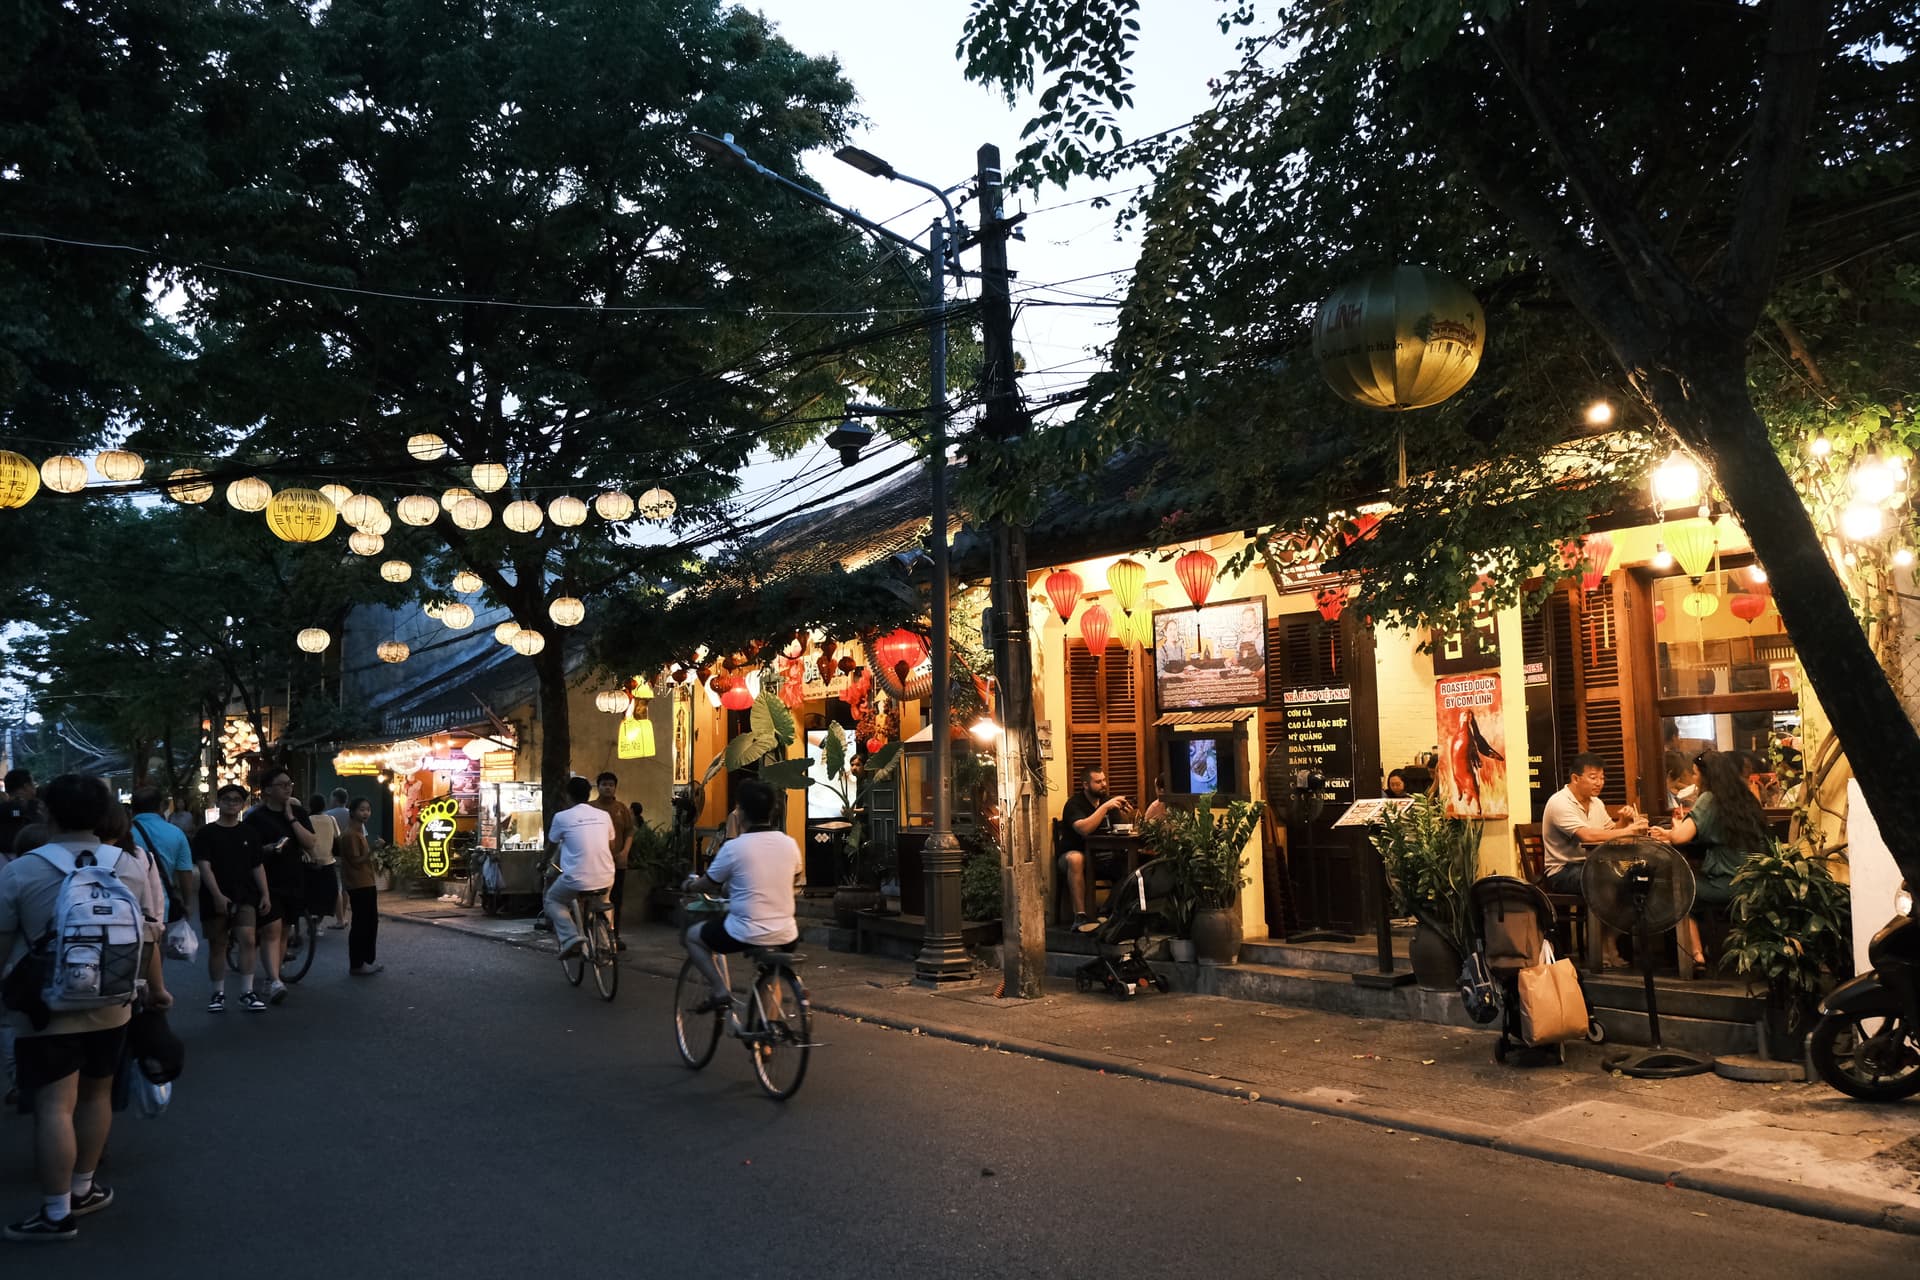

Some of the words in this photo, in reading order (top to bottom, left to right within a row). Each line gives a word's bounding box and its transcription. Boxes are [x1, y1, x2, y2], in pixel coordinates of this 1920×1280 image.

[1441, 681, 1473, 694] ROASTED
[1475, 679, 1495, 690] DUCK
[1334, 688, 1350, 701] NAM
[1446, 698, 1454, 708] BY
[1456, 696, 1473, 707] COM
[1475, 694, 1492, 705] LINH
[1288, 721, 1301, 729] CAO
